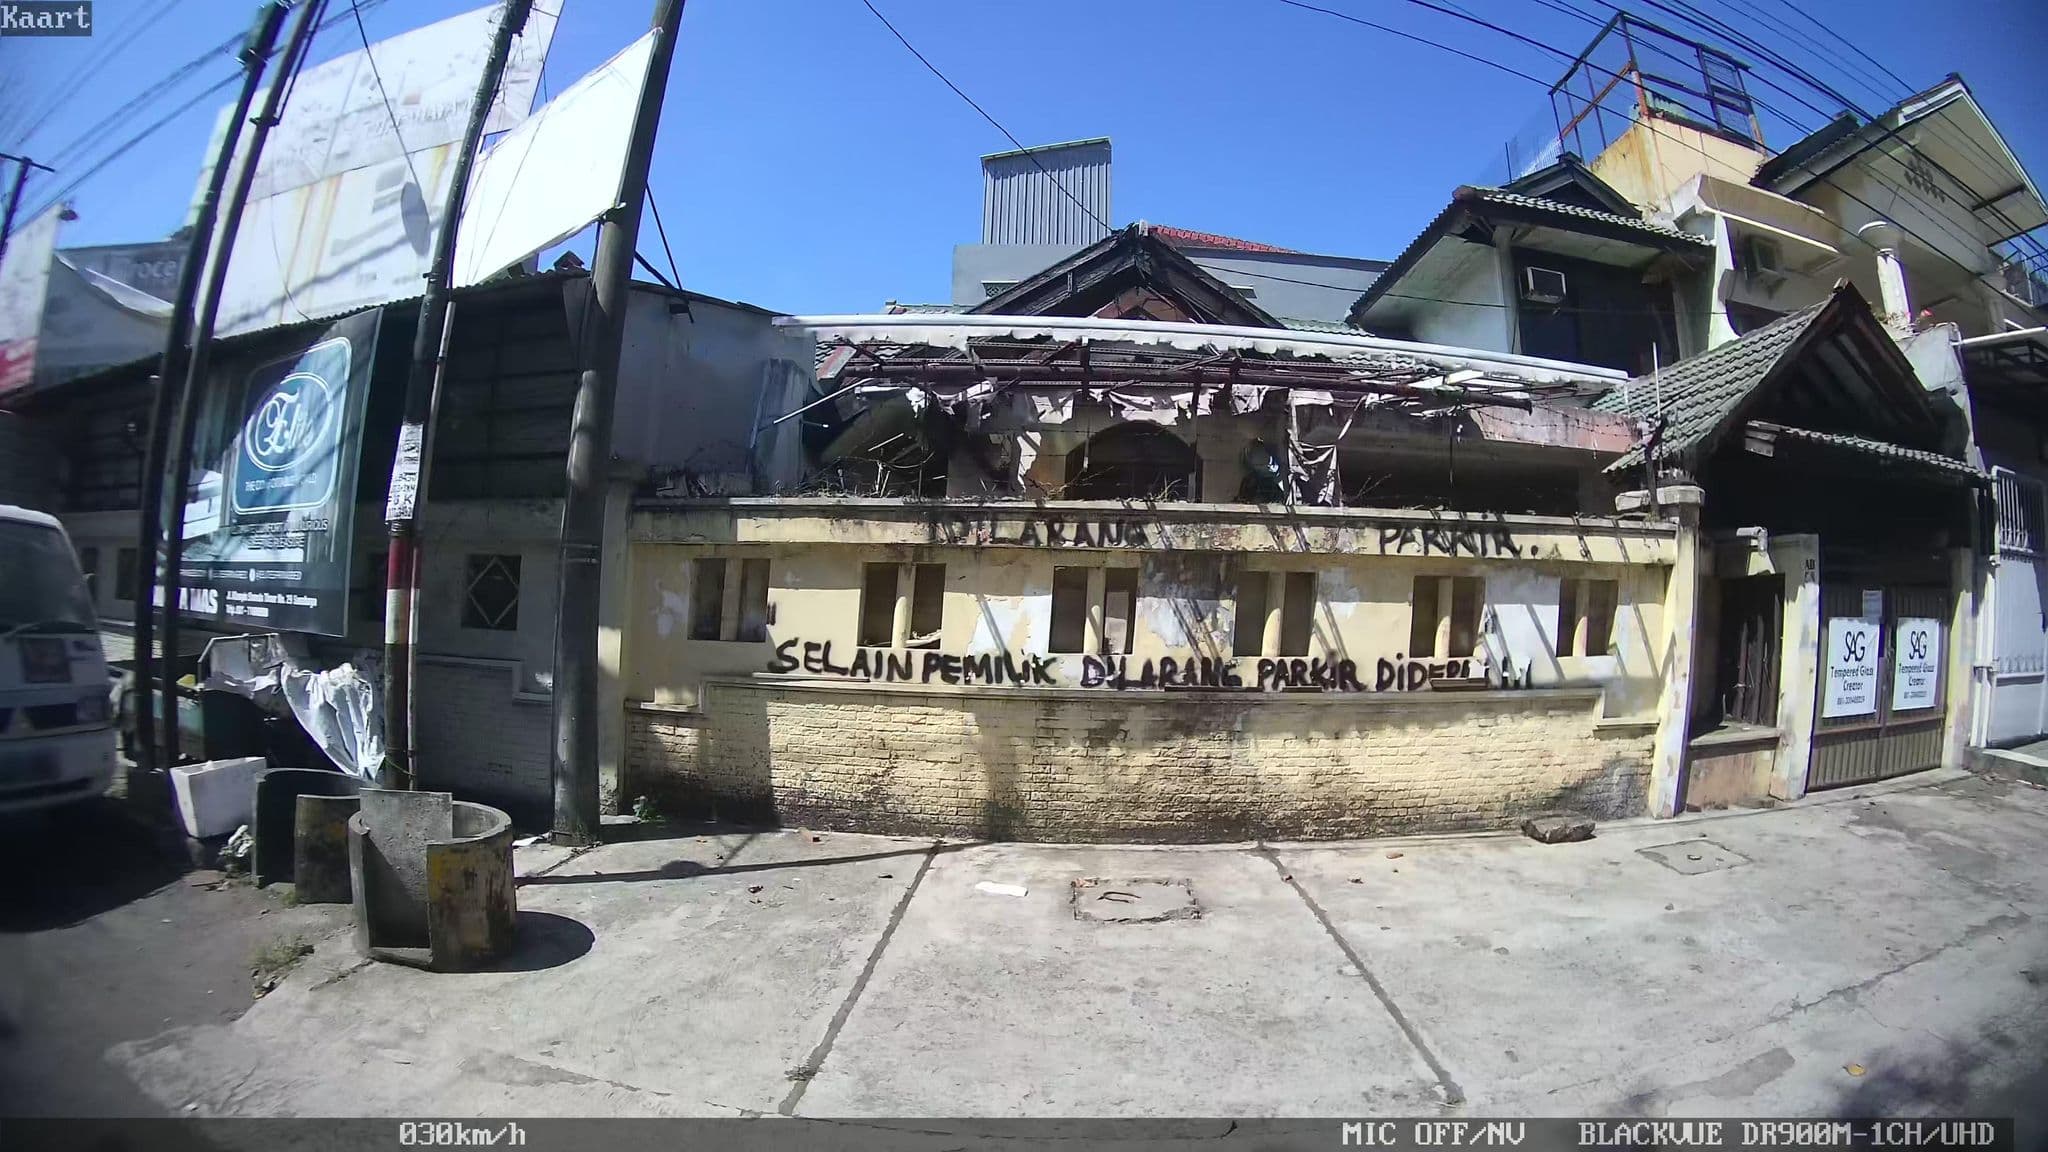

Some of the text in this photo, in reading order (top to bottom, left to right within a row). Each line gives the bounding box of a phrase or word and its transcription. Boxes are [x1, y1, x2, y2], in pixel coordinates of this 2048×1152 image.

[1843, 630, 1866, 663] SAG
[1909, 630, 1927, 661] SAG
[767, 637, 912, 682] SELAIN
[922, 649, 1060, 685] PEMILIK
[1081, 654, 1243, 690] DILARANG
[1257, 653, 1367, 691] PARKIR
[1831, 665, 1860, 679] Tempered
